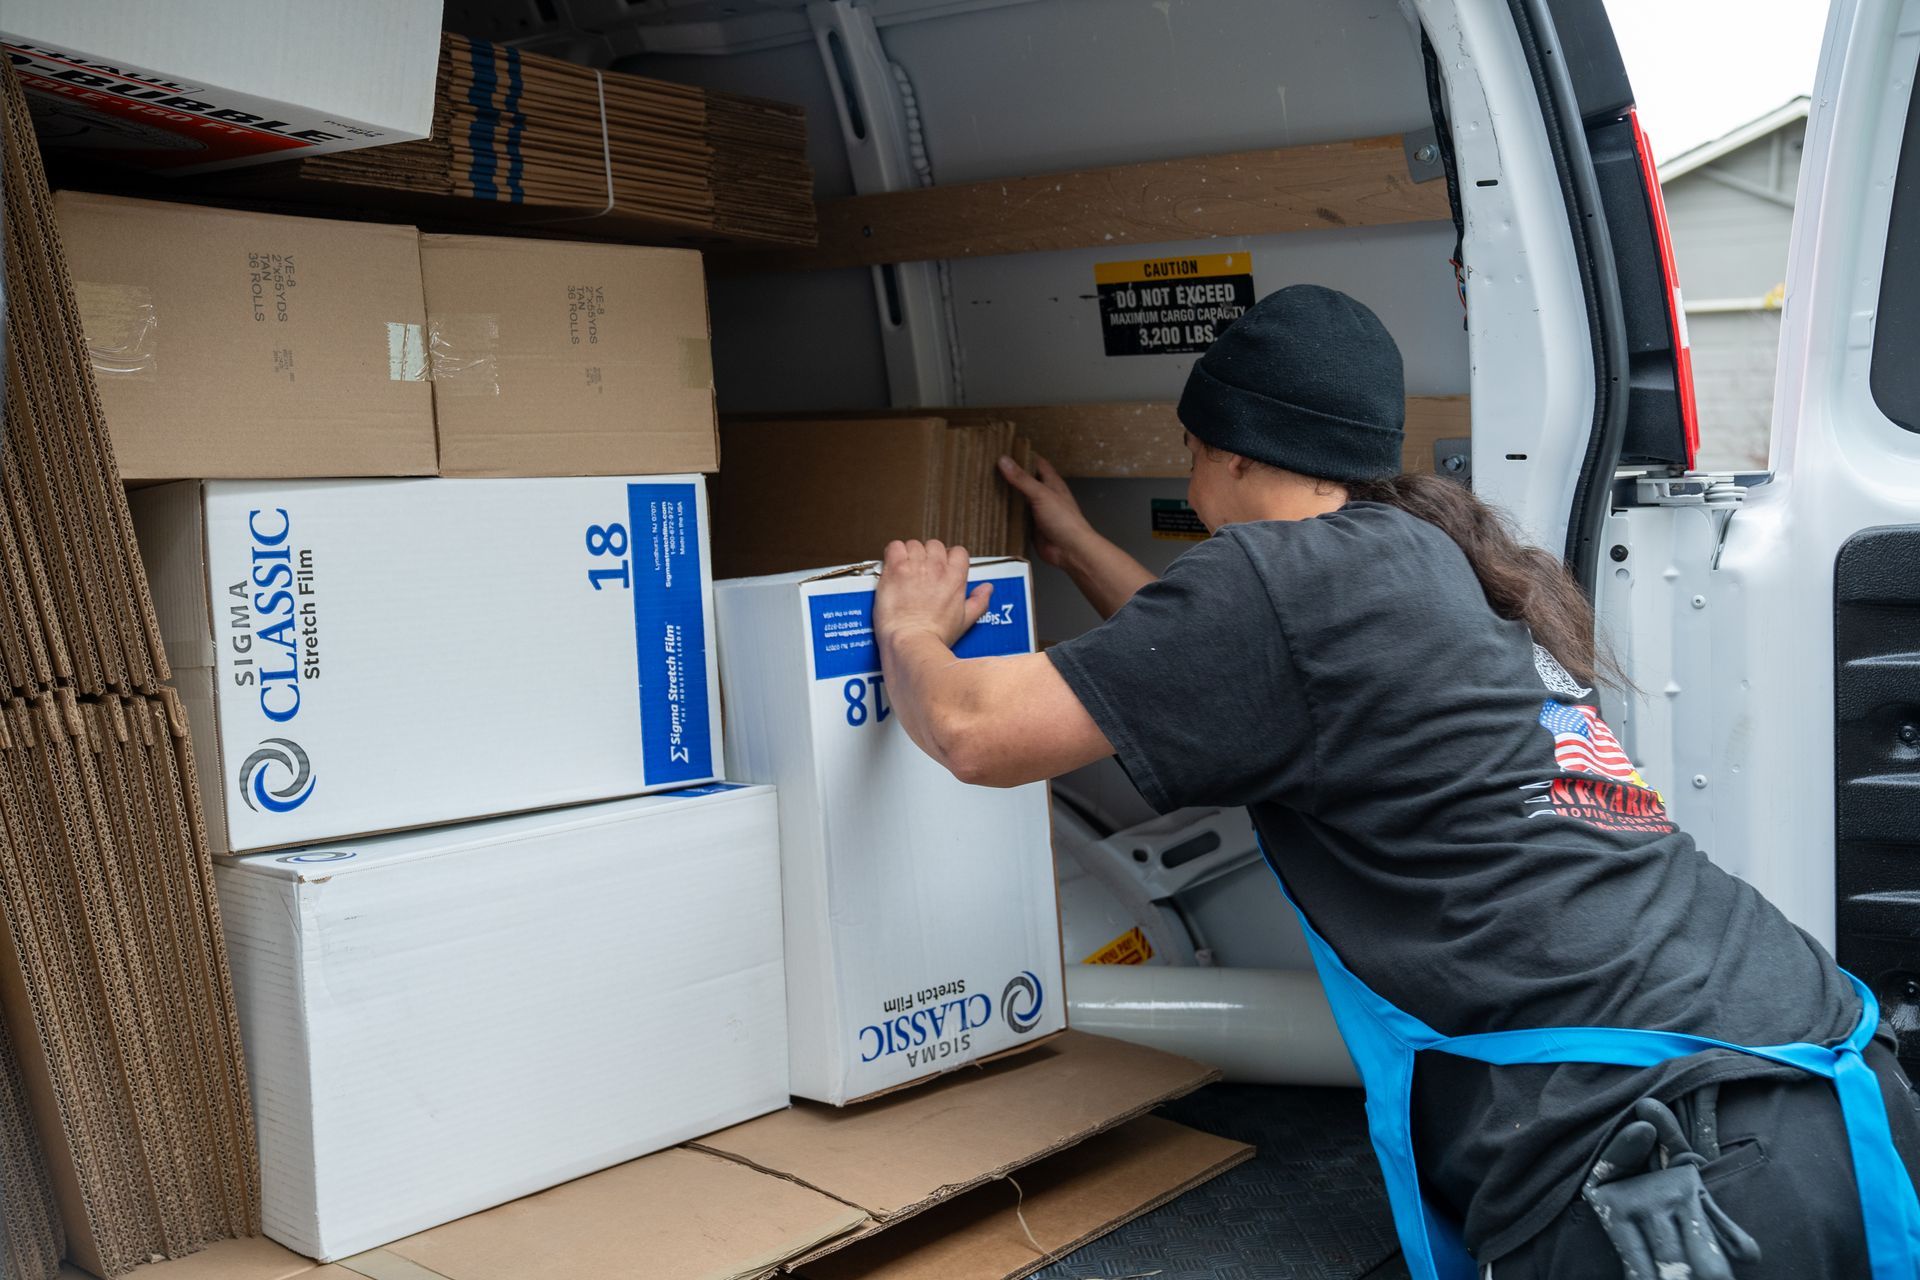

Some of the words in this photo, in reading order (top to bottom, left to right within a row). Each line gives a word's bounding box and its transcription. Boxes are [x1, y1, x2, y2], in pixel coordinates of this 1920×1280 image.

[199, 121, 253, 135] FT
[248, 252, 260, 268] 36
[260, 253, 272, 281] TAN
[284, 255, 297, 288] VE-8
[1144, 260, 1198, 277] CAUTION
[250, 272, 265, 322] ROLLS
[577, 286, 586, 311] TAN
[1116, 289, 1136, 308] DO
[1141, 288, 1170, 306] NOT
[1176, 283, 1235, 306] EXCEED
[569, 303, 580, 345] ROLLS
[1110, 310, 1159, 326] MAXIMUM
[1161, 308, 1195, 323] CARGO
[1197, 306, 1246, 322] CAPACTY
[1139, 326, 1181, 348] 3,200
[1185, 325, 1218, 345] LBS.
[652, 523, 658, 533] NJ
[297, 549, 314, 597] Film
[586, 522, 630, 591] 18
[249, 508, 301, 723] CLASSIC
[229, 580, 255, 686] SIGMA
[300, 602, 320, 680] Stretch
[664, 624, 675, 653] Film
[666, 655, 679, 701] Stretch
[844, 674, 890, 727] 18
[670, 704, 683, 745] Sigma
[883, 994, 913, 1013] Film
[918, 979, 965, 1003] Stretch
[859, 993, 992, 1063] CLASSIC
[906, 1034, 971, 1068] SIGMA
